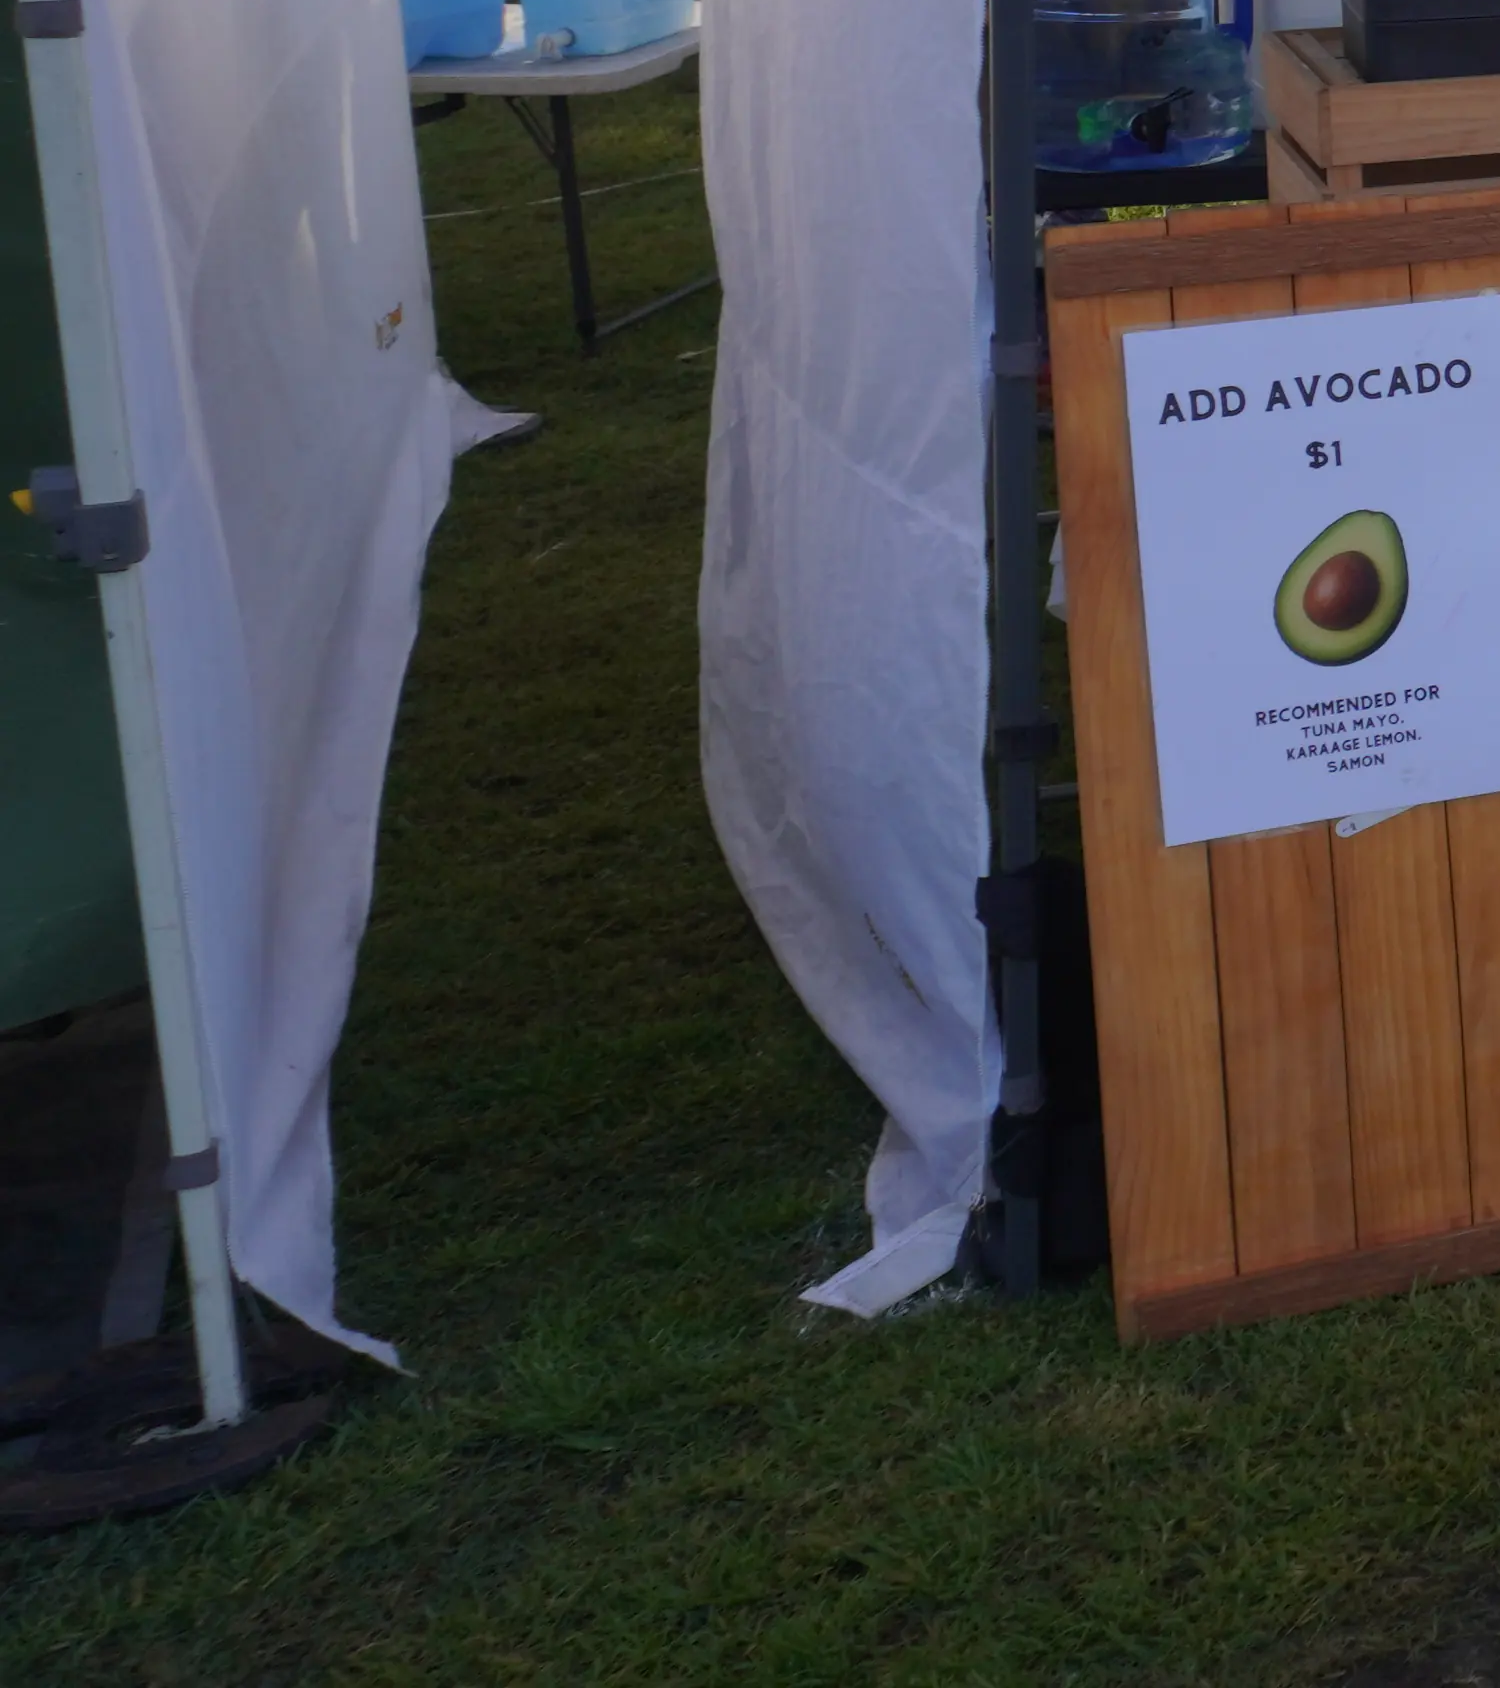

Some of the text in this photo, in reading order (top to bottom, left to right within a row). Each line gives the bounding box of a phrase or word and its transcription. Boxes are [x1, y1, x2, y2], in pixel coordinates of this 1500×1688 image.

[1159, 357, 1473, 425] ADD AVOCADO
[1305, 438, 1344, 470] $1
[1255, 685, 1440, 727] RECOMMENDED FOR
[1301, 721, 1347, 739] TUNA
[1286, 737, 1360, 761] KARAAGE
[1326, 753, 1386, 773] SAMON
